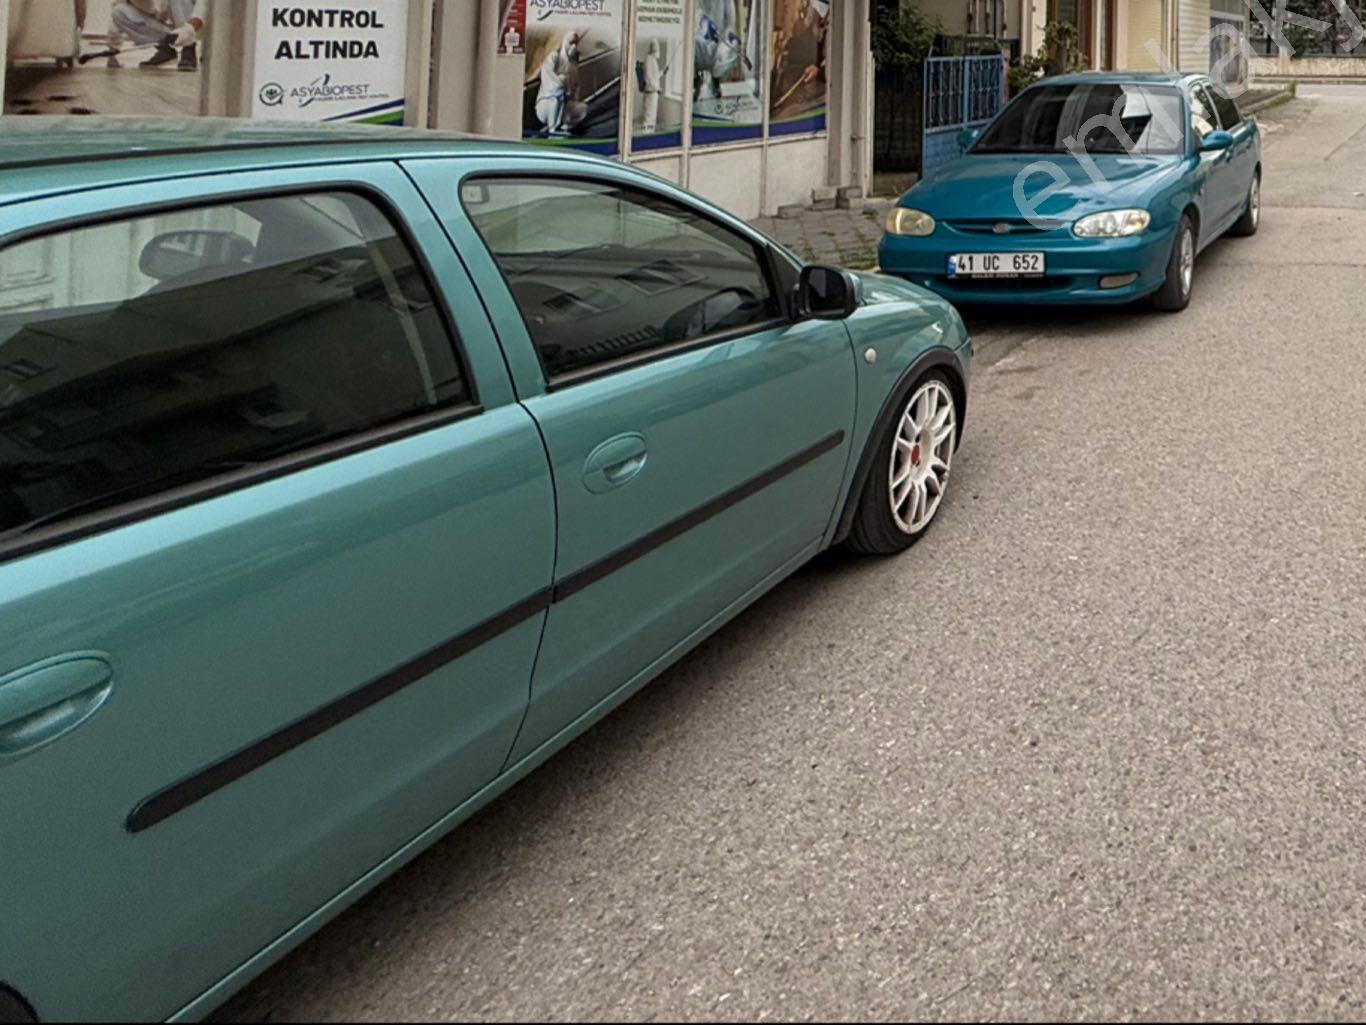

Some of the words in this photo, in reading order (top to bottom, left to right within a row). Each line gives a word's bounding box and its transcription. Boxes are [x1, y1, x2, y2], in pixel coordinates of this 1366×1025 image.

[272, 7, 384, 28] KONTROL
[274, 40, 380, 60] ALTINDA
[958, 255, 974, 271] 41
[983, 255, 1000, 271] UC
[1013, 254, 1039, 270] 652
